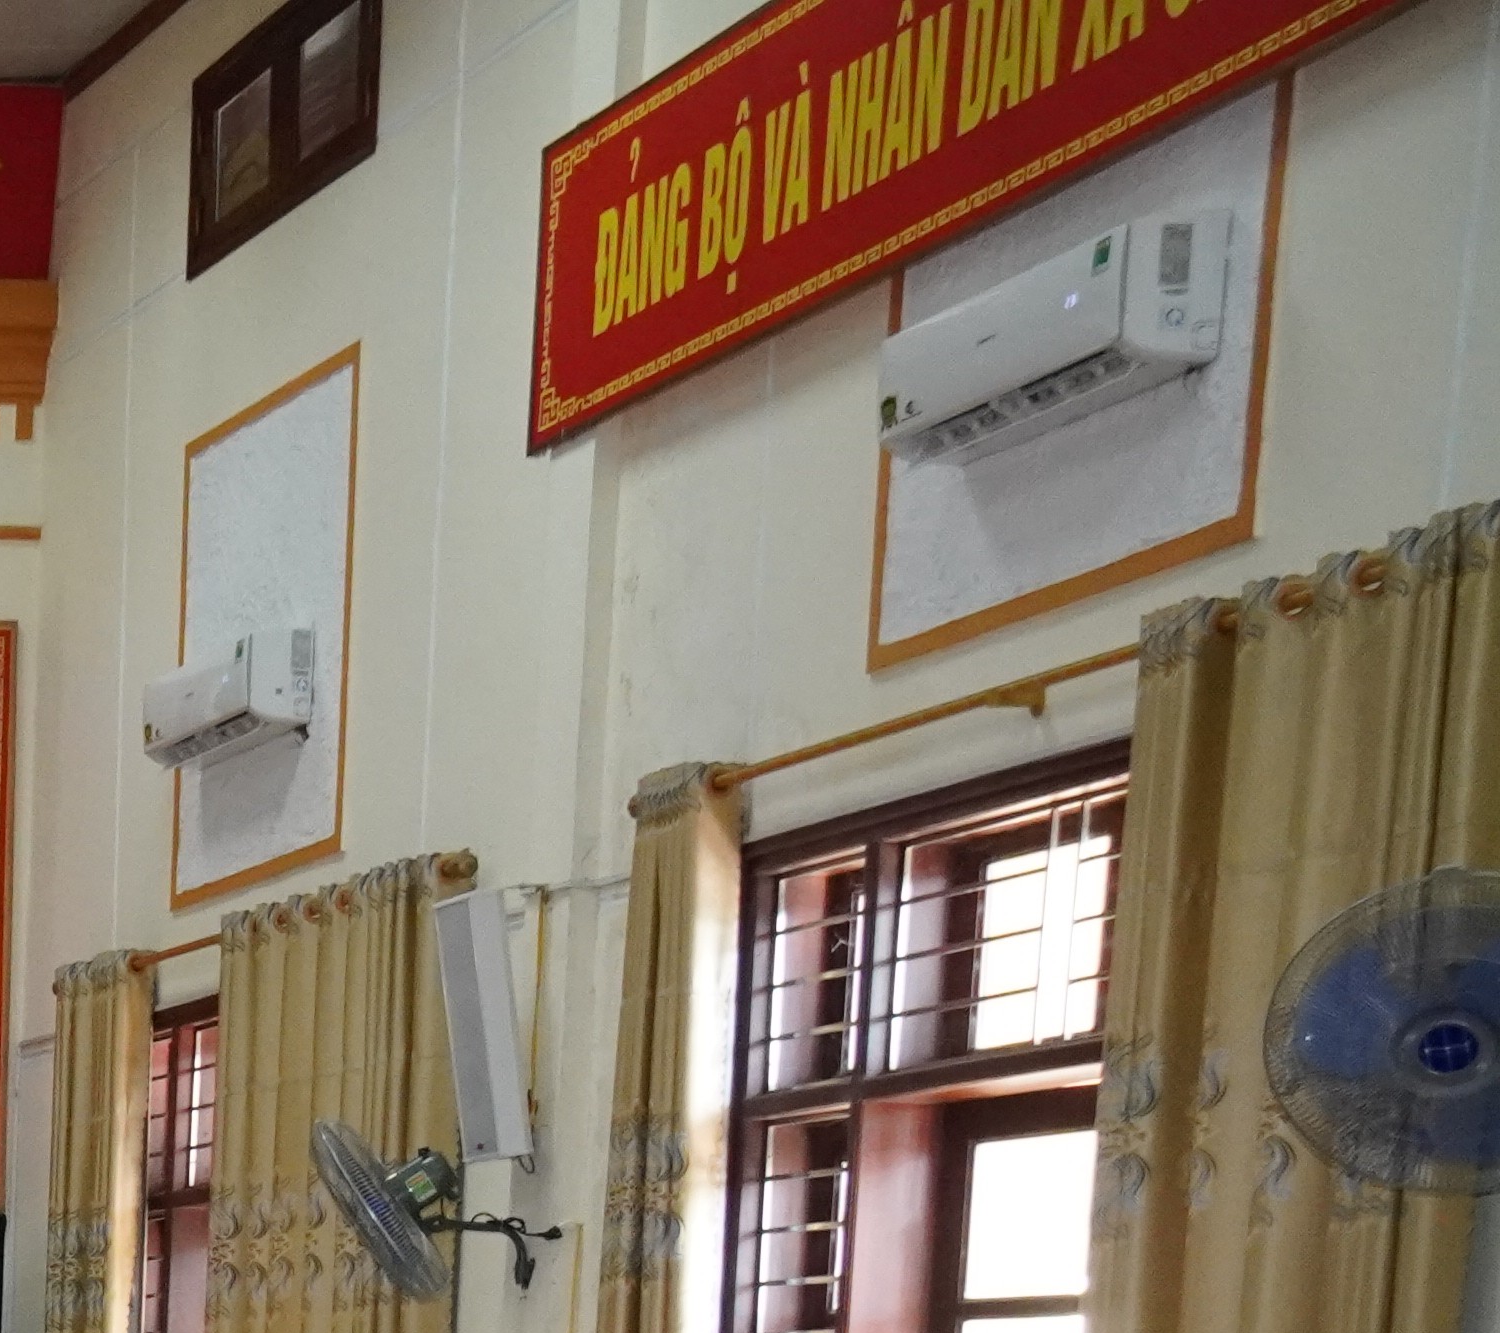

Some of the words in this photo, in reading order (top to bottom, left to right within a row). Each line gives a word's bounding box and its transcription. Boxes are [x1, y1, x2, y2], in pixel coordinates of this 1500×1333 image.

[592, 135, 690, 338] ĐẢNG
[698, 96, 752, 295] BỘ
[762, 62, 811, 246] VÀ
[822, 0, 952, 212] NHÂN
